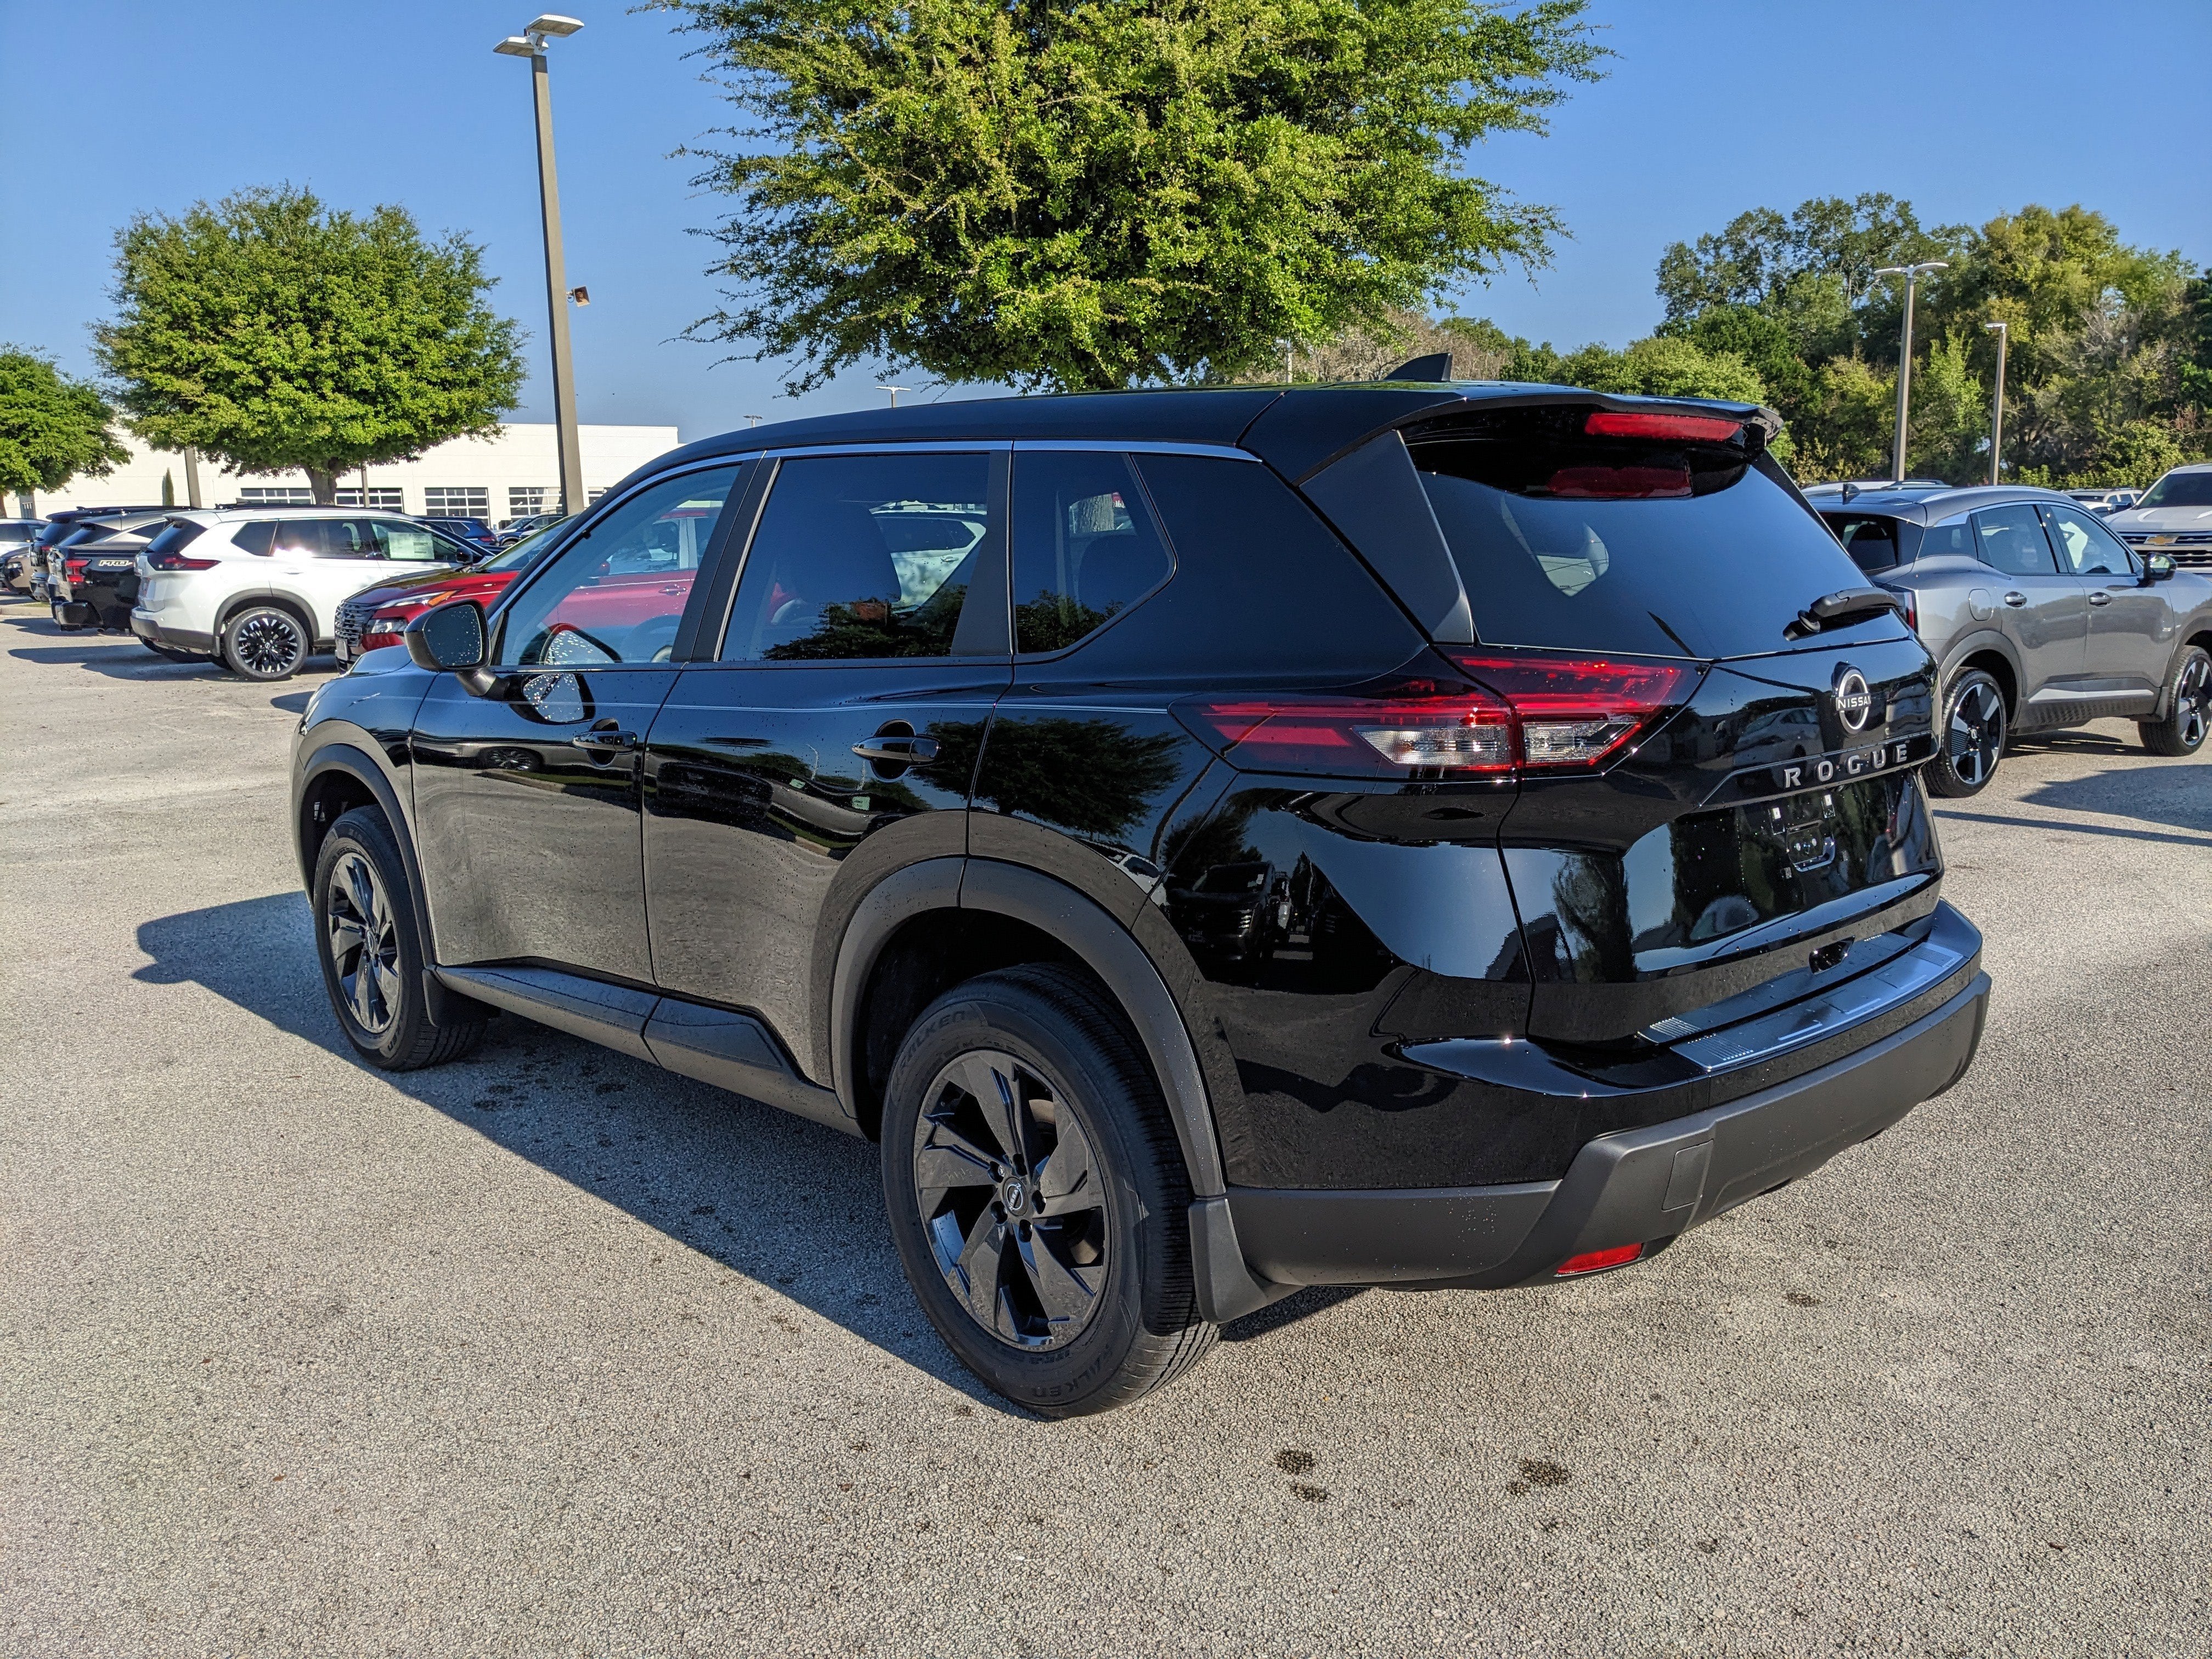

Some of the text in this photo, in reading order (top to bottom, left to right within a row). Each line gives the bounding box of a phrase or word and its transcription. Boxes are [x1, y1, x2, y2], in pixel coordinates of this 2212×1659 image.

[1837, 695, 1871, 709] NISSAN
[1783, 743, 1908, 789] ROGUE
[1009, 1182, 1022, 1210] NISSAN
